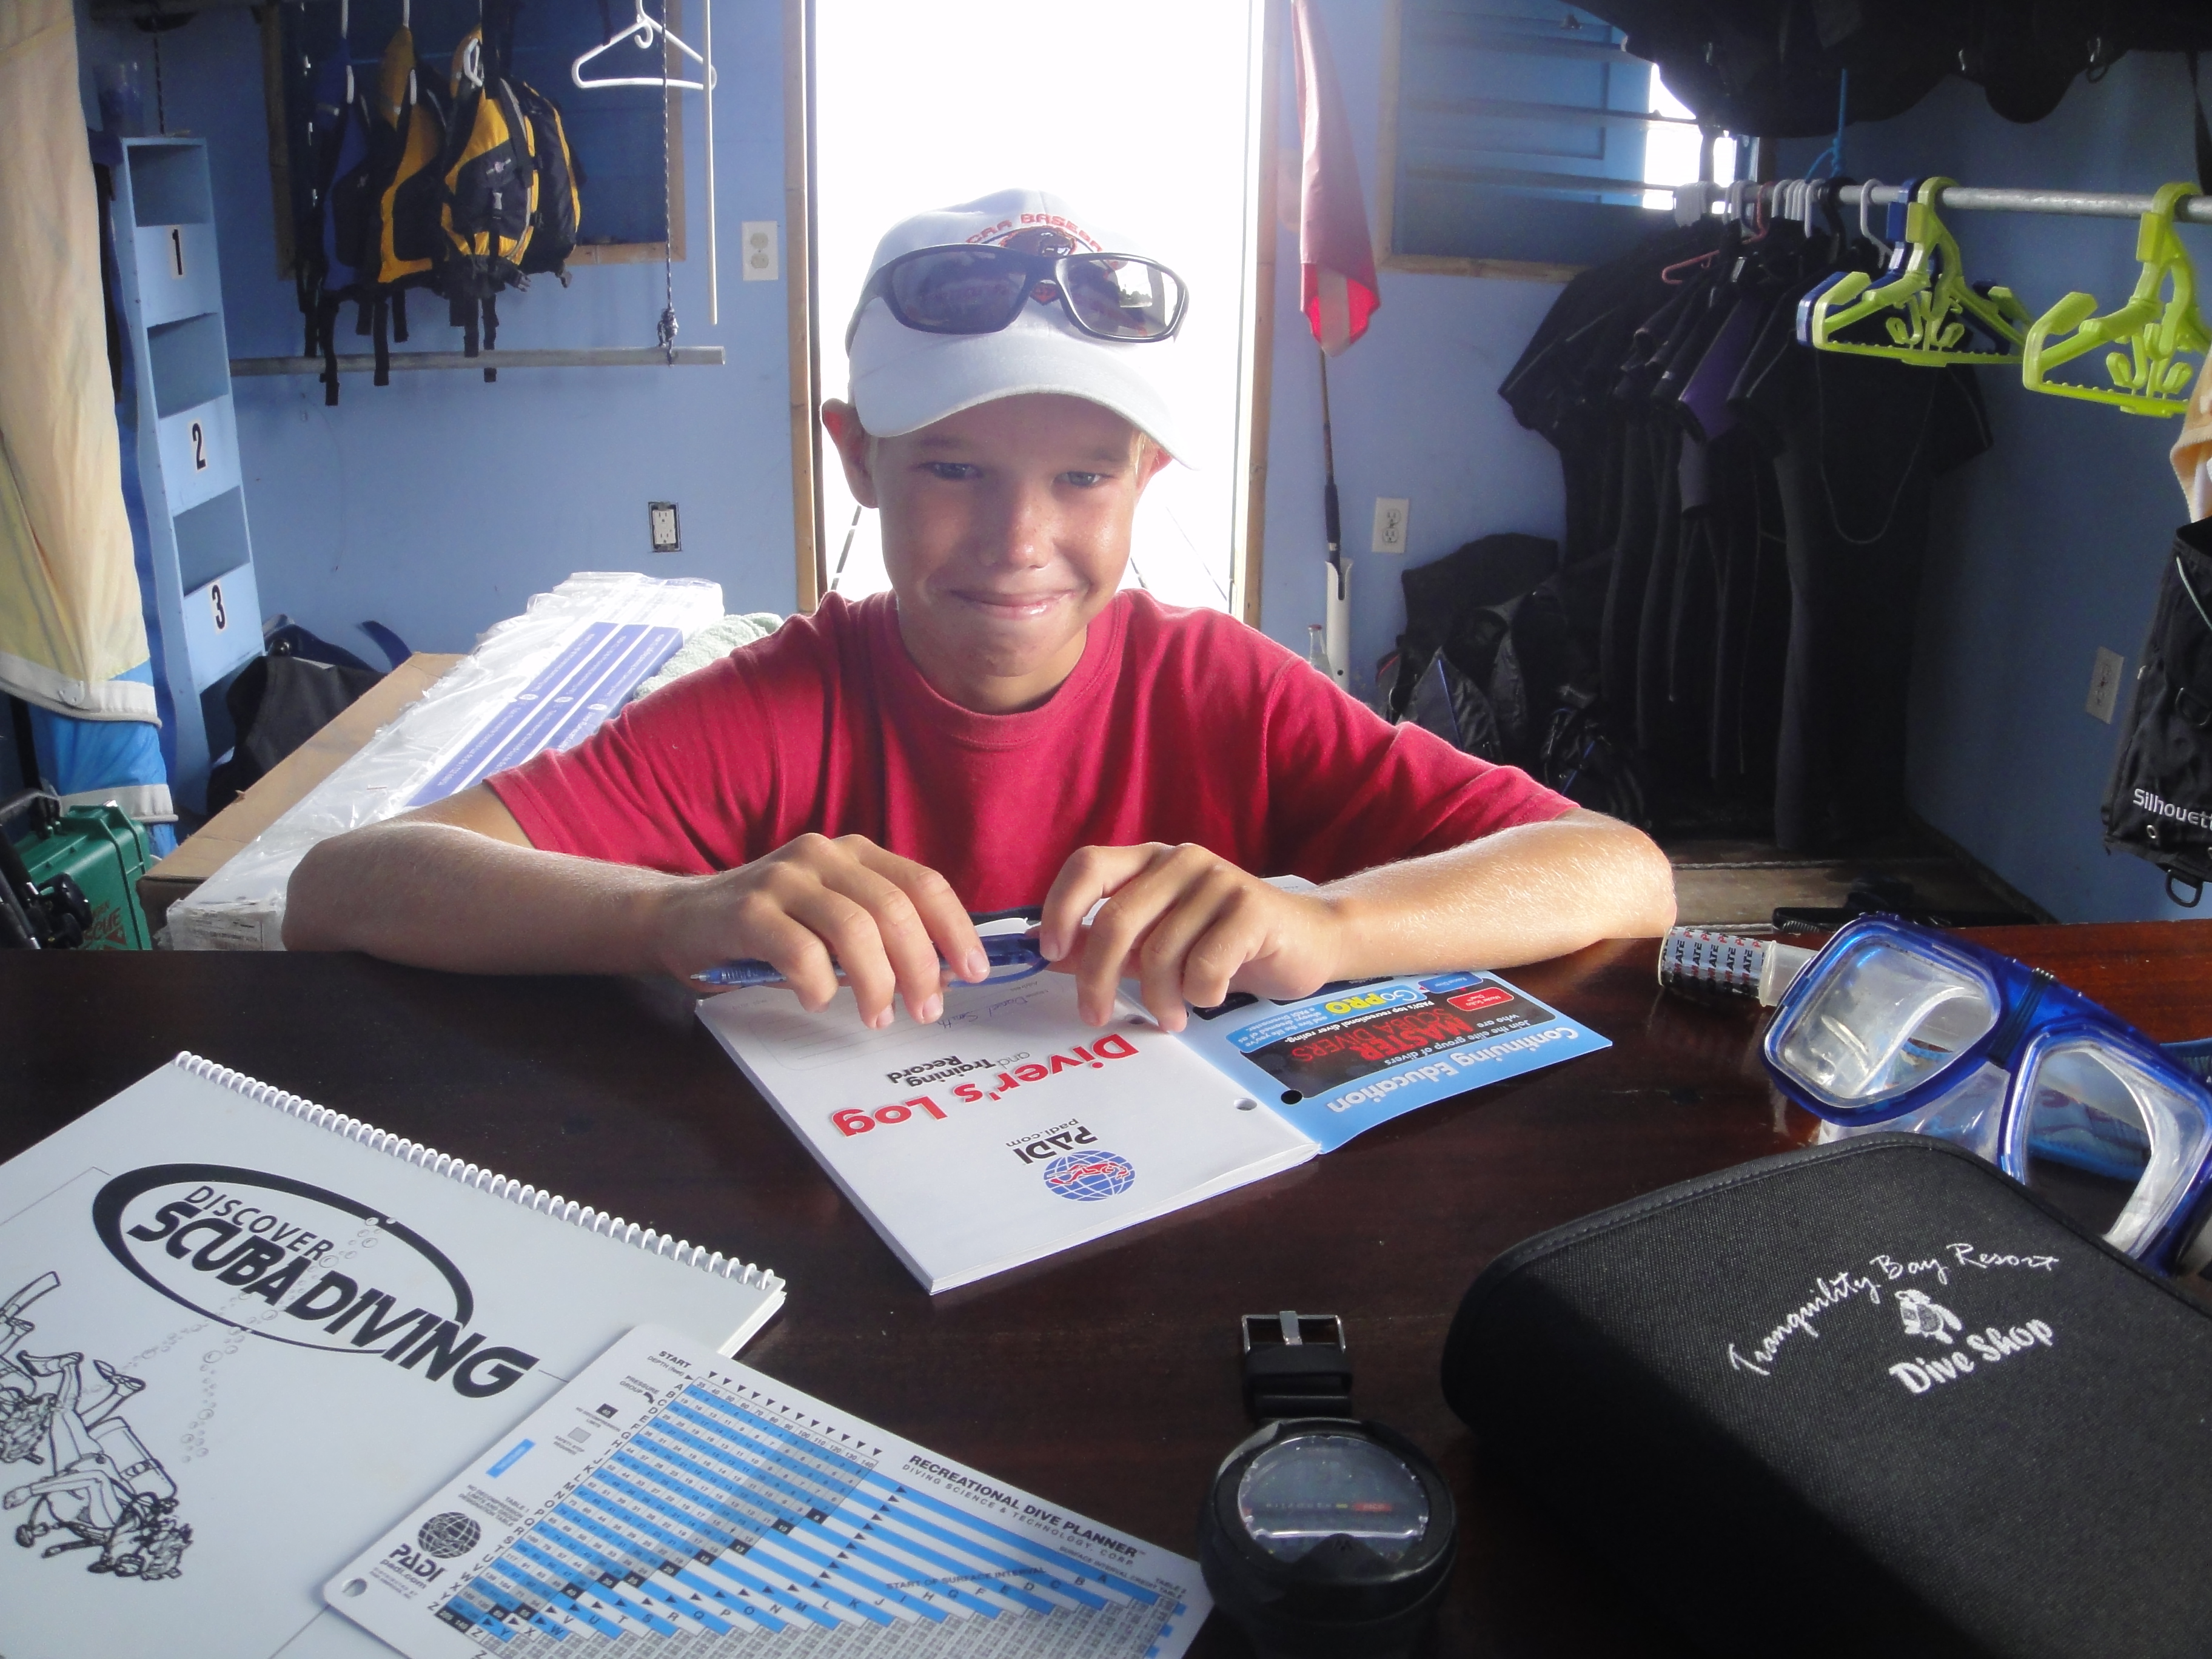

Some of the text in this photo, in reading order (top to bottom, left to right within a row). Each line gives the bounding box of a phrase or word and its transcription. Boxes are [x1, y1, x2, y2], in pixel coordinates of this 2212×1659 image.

[1021, 213, 1103, 252] BASEBA
[172, 229, 183, 275] 1
[192, 423, 207, 468] 2
[213, 585, 226, 631] 3
[1285, 1001, 1435, 1044] PADI's top recreational diver rating.
[1476, 1013, 1520, 1028] who are
[1292, 1008, 1453, 1062] SCUBA DIVERS
[1349, 1011, 1473, 1061] MASTER
[1384, 1019, 1531, 1065] Join the elite group of divers
[886, 1056, 964, 1084] Record
[909, 1051, 1030, 1087] and Training
[1327, 1027, 1579, 1113] Continuing Education
[831, 1034, 1139, 1137] Diver's Log
[1005, 1118, 1079, 1148] padi.com
[1013, 1125, 1099, 1164] PADI
[184, 1185, 334, 1261] DISCOVER
[127, 1201, 540, 1398] SCUBA DIVING
[1729, 1242, 2059, 1376] Tranquility Bay Resort
[647, 1356, 668, 1369] DEPTH
[659, 1350, 691, 1369] START
[1889, 1319, 2054, 1394] Dive Shop
[619, 1380, 643, 1394] GROUP
[625, 1375, 660, 1395] PRESSURE
[697, 1381, 706, 1389] 35
[797, 1429, 811, 1439] 100
[814, 1437, 826, 1446] 110
[829, 1444, 842, 1453] 120
[845, 1452, 858, 1461] 130
[860, 1459, 874, 1468] 140
[612, 1439, 622, 1448] H
[583, 1465, 594, 1473] K
[563, 1482, 575, 1491] M
[902, 1464, 941, 1486] DIVING
[945, 1482, 996, 1509] SCIENCE
[999, 1506, 1007, 1515] &
[909, 1455, 1020, 1510] RECREATIONAL
[1023, 1504, 1060, 1527] DIVE
[514, 1527, 525, 1535] R
[389, 1542, 447, 1583] PADI
[483, 1554, 494, 1563] U
[379, 1558, 427, 1589] padi.com
[450, 1583, 461, 1591] X
[885, 1566, 1047, 1590] START OF SURFACE INTERVAL
[1074, 1577, 1085, 1585] B
[427, 1601, 440, 1611] Z
[770, 1604, 781, 1614] N
[822, 1601, 829, 1609] L
[923, 1592, 934, 1601] H
[563, 1615, 574, 1624] V
[618, 1615, 628, 1623] T
[668, 1612, 679, 1621] R
[471, 1628, 483, 1637] Z
[524, 1628, 535, 1637] X
